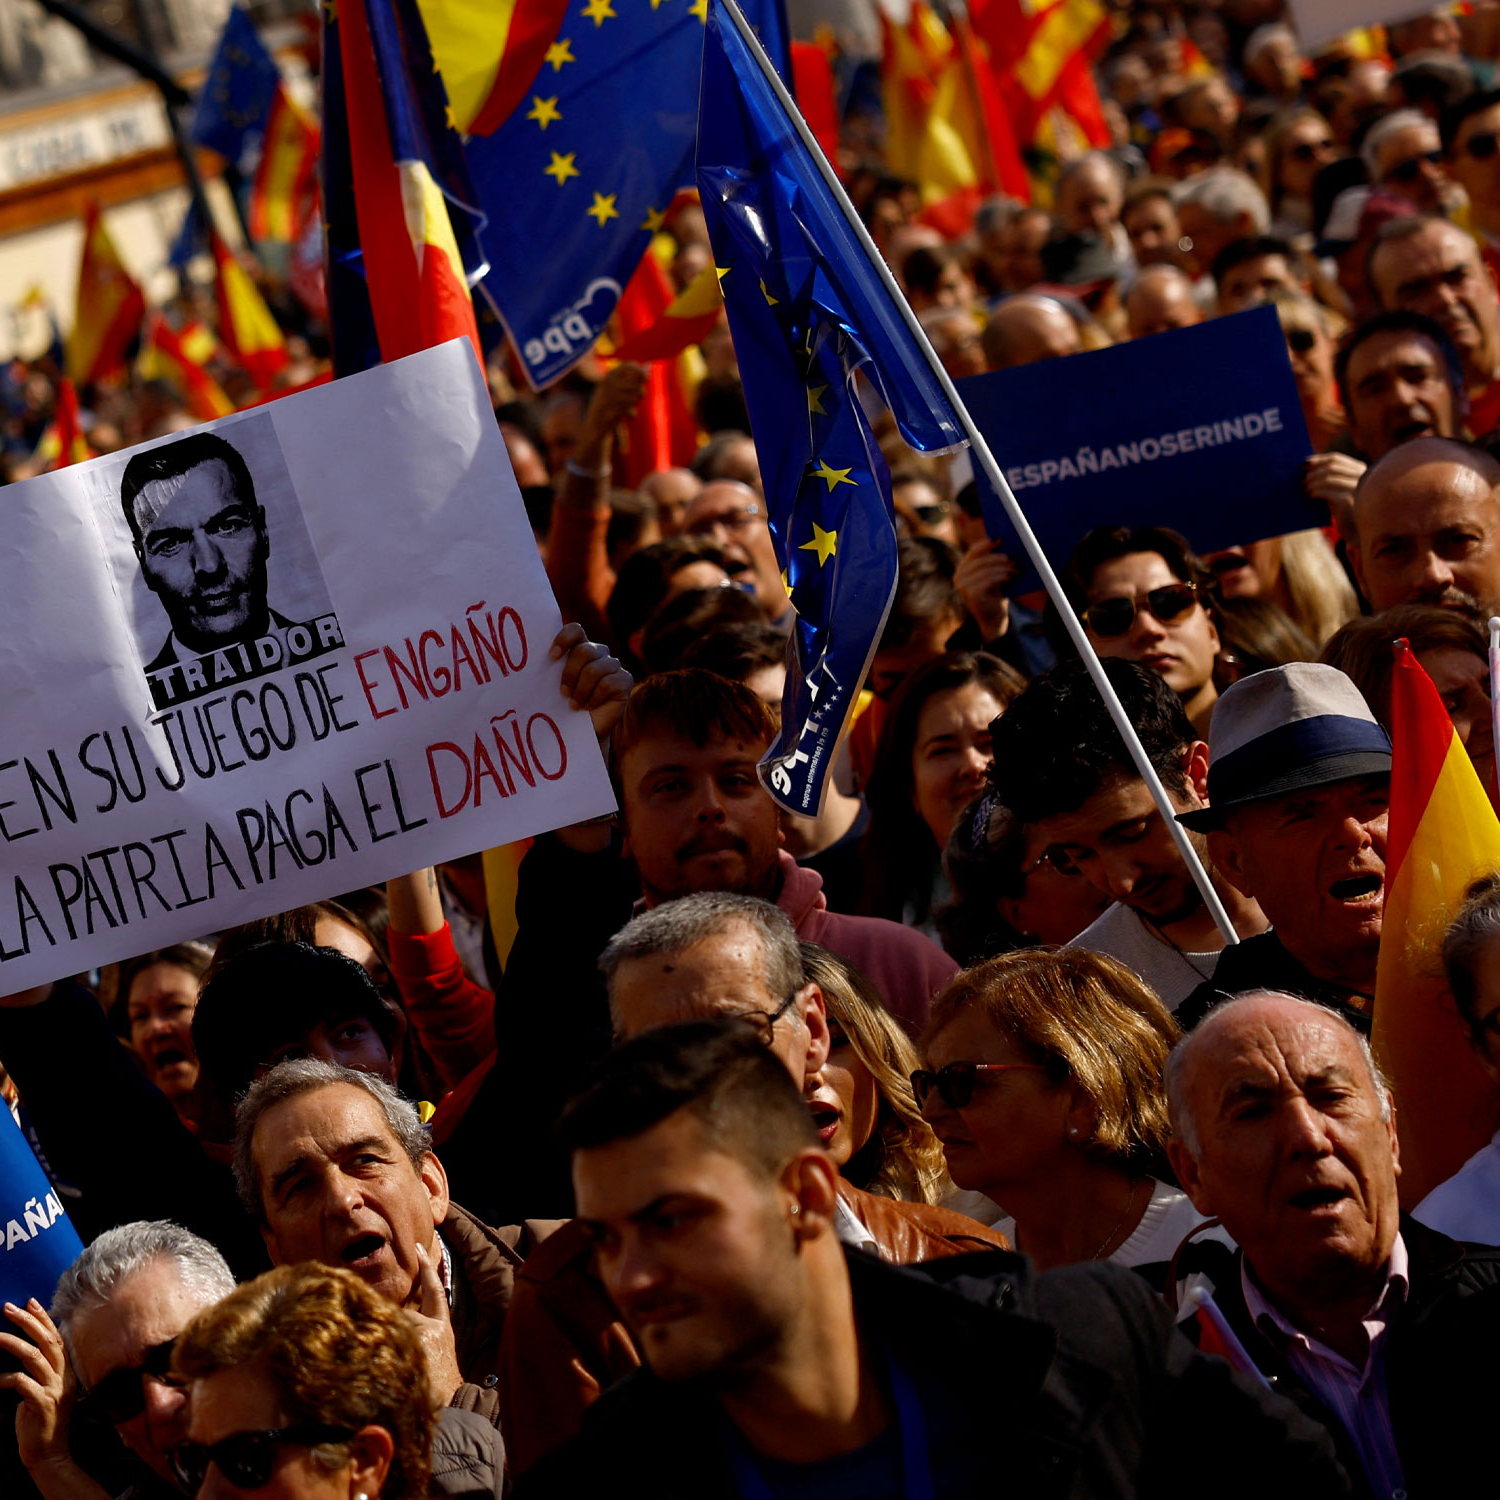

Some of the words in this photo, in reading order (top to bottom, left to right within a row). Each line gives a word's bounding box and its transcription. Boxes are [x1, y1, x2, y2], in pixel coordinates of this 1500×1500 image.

[78, 725, 147, 813] SU
[151, 682, 297, 791] JUEGO
[293, 662, 359, 741] DE
[353, 600, 528, 720] ENGAÑO
[156, 615, 344, 700] TRAIDOR
[48, 822, 246, 940] PATRIA
[236, 782, 358, 885] PAGA
[354, 758, 428, 843] EL
[425, 709, 568, 819] DAÑO
